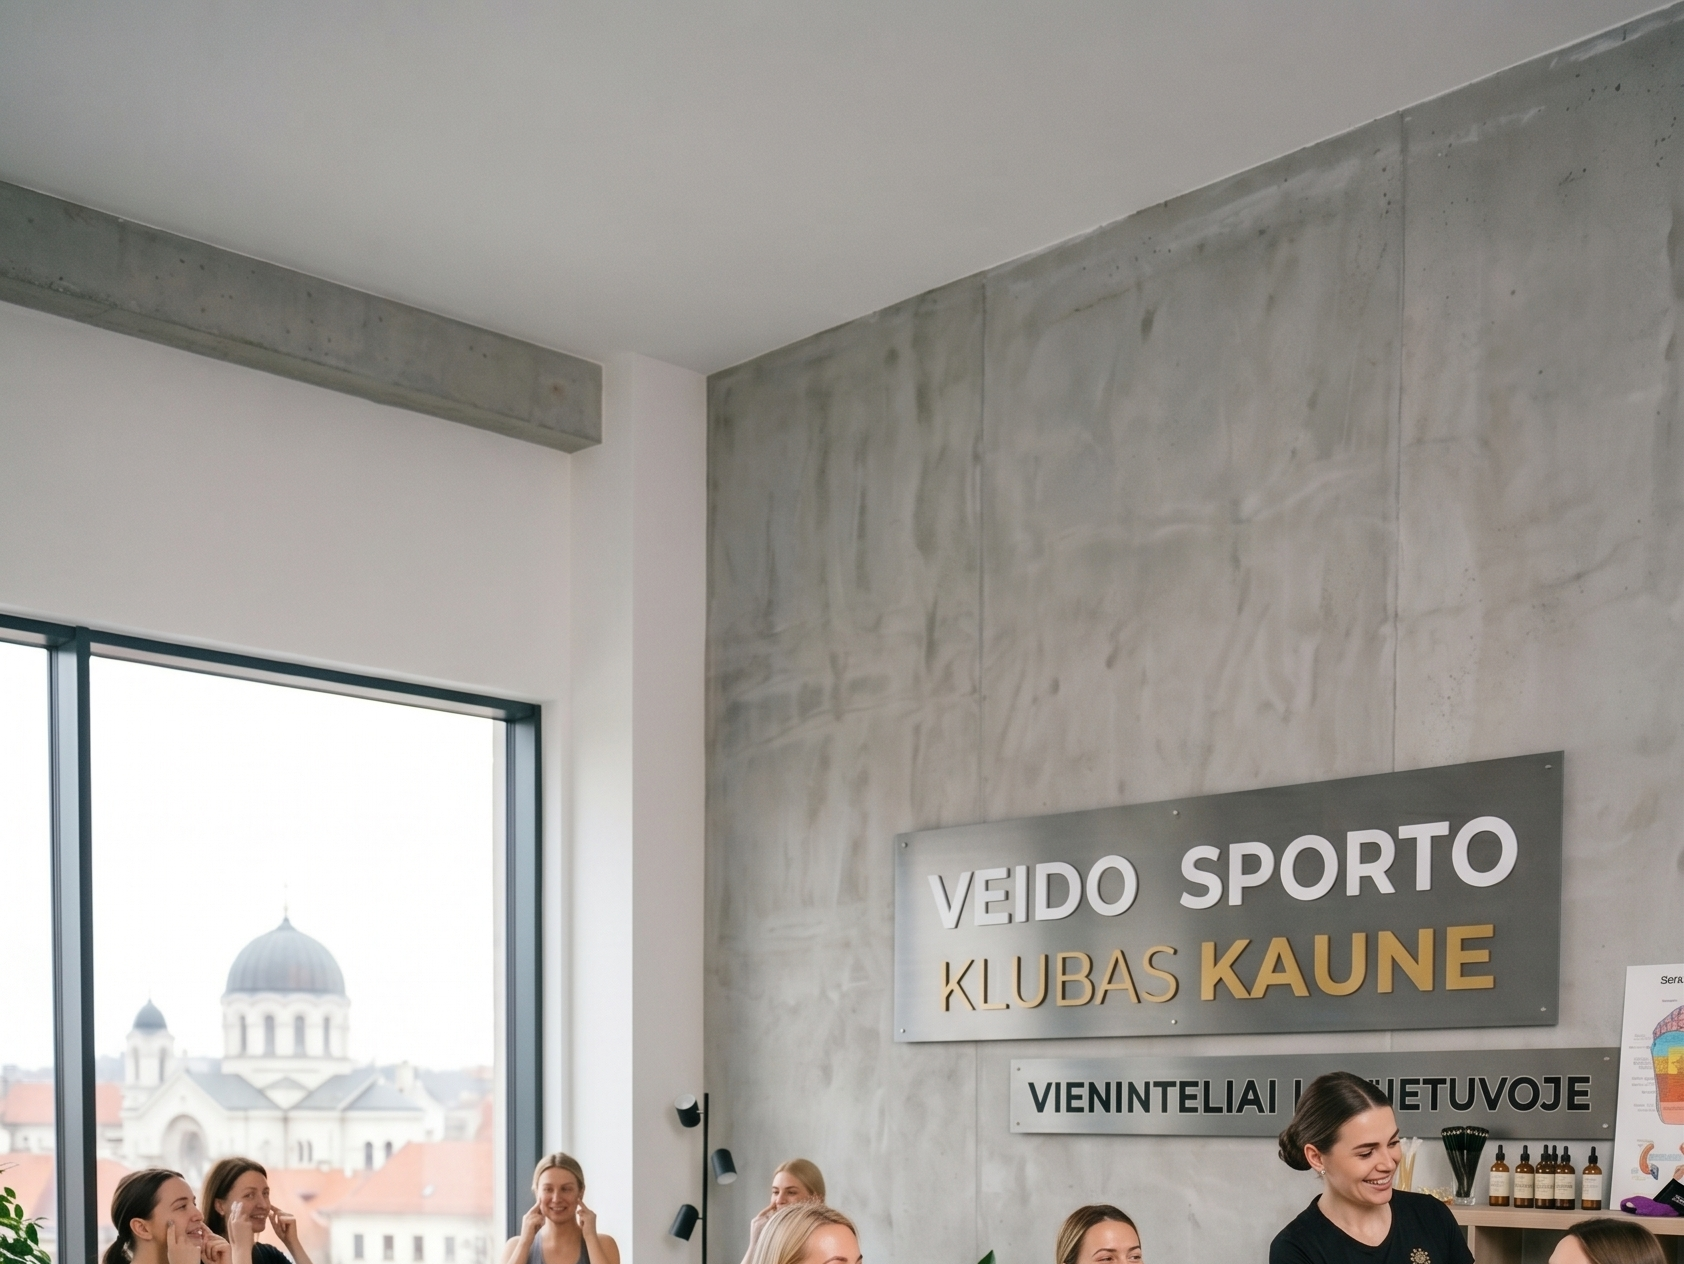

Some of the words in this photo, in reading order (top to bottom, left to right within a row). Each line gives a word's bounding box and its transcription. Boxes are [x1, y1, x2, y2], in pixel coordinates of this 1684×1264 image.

[927, 855, 1139, 929] VEIDO
[1179, 816, 1518, 909] SPORTO
[940, 946, 1179, 1012] KLUBAS
[1200, 924, 1495, 1001] KAUNE
[1027, 1079, 1277, 1114] VIENINTELIAI
[1365, 1075, 1592, 1112] IETUVOJE
